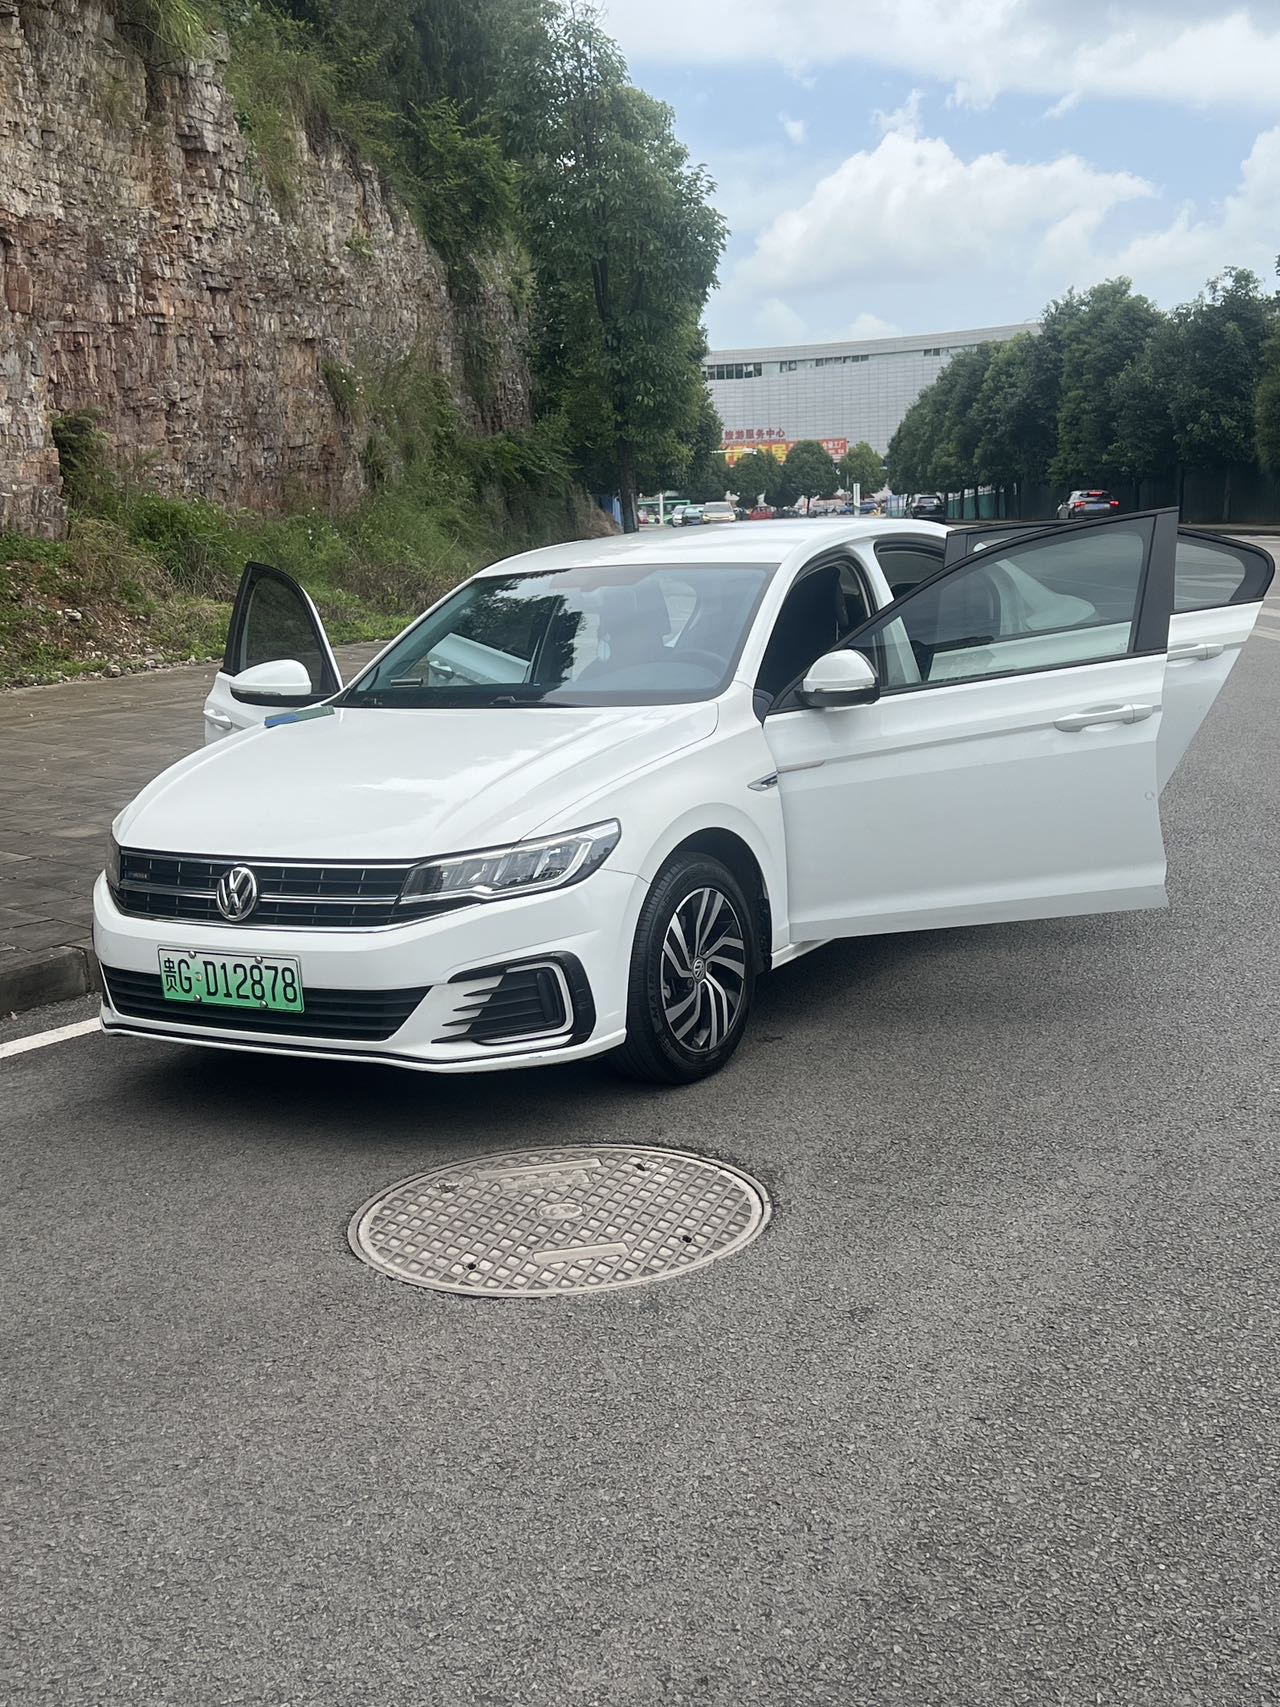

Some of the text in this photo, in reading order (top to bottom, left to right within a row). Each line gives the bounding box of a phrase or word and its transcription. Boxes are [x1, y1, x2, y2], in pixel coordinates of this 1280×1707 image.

[724, 427, 785, 441] 旅游服务中心
